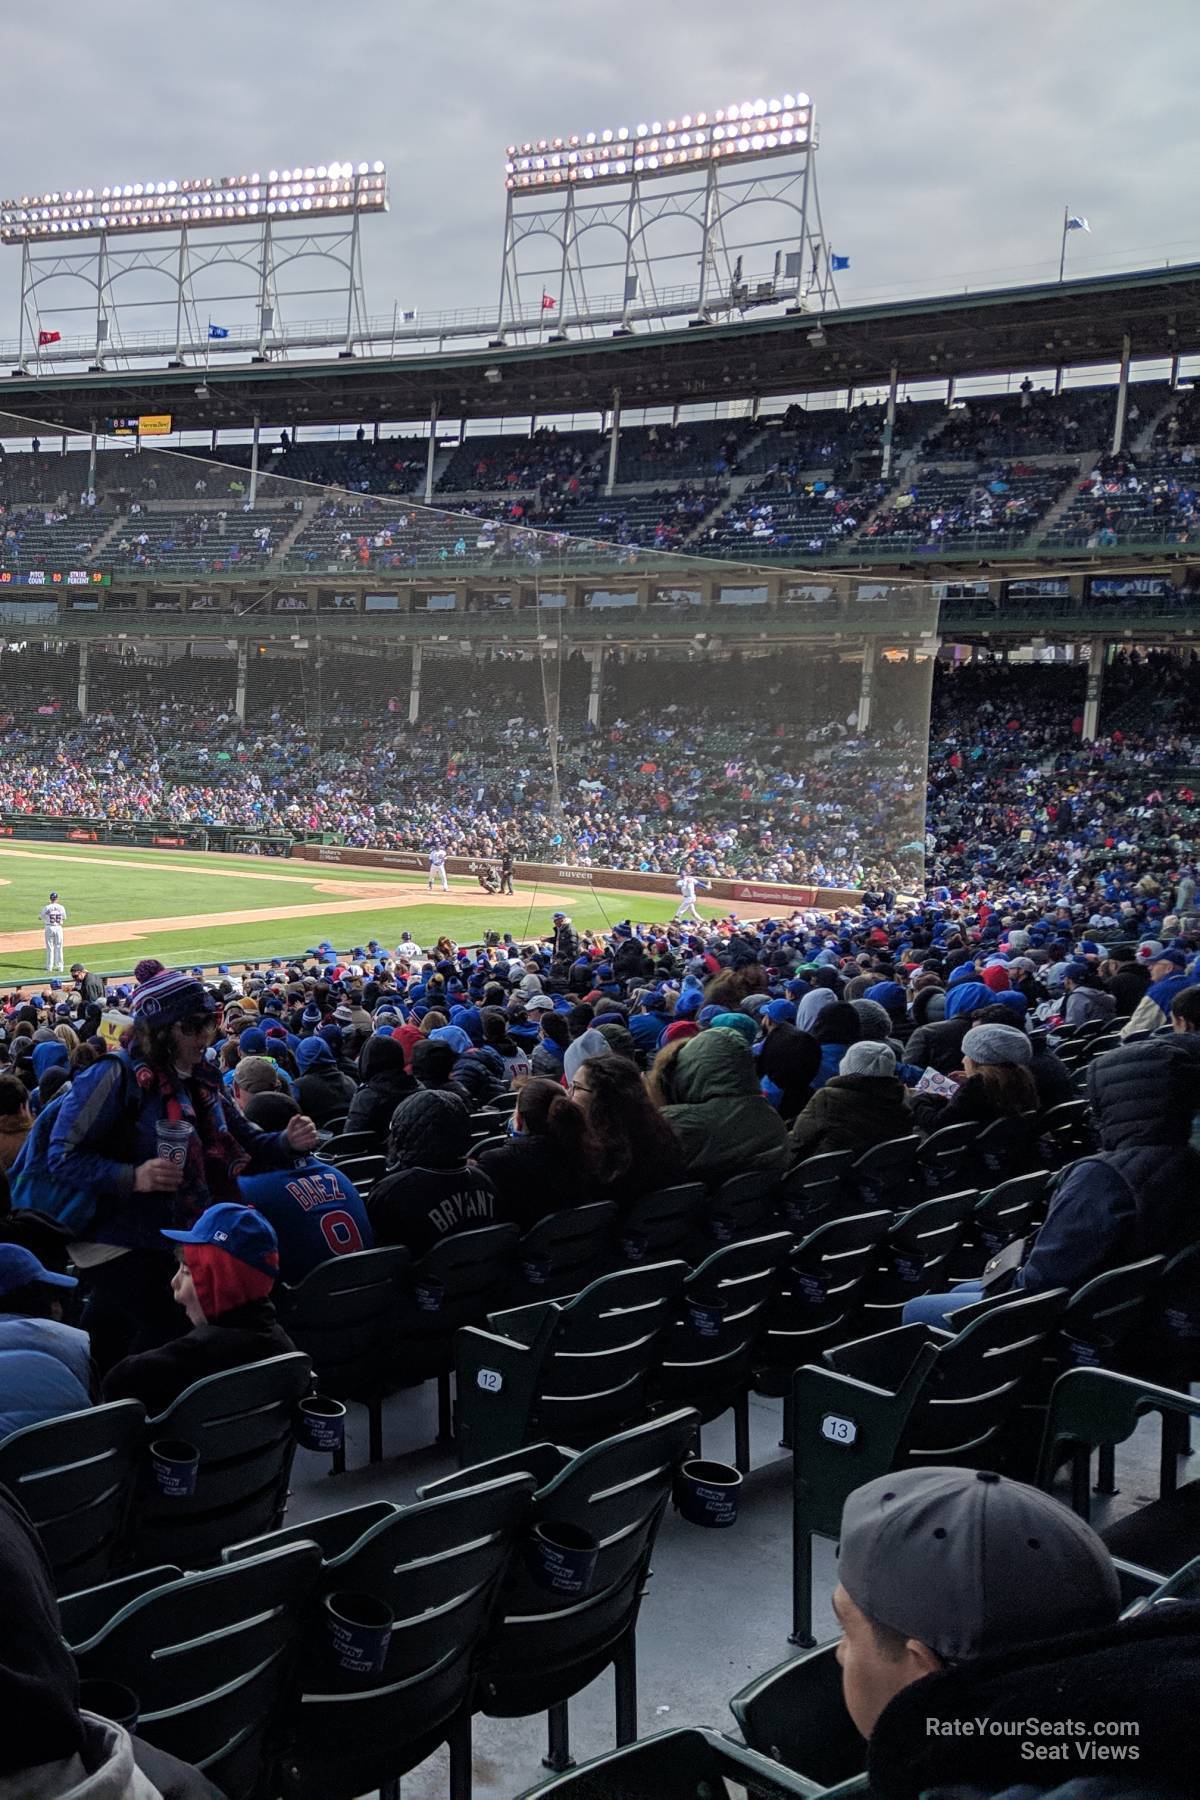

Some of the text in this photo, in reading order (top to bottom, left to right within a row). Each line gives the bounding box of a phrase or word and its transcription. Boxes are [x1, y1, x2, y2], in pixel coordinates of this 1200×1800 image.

[28, 577, 46, 585] COUNT
[67, 577, 89, 585] PERCENT
[559, 870, 593, 880] nuveen
[285, 1173, 346, 1212] BAEZ
[428, 1190, 497, 1233] BRYANT
[482, 1373, 497, 1388] 12
[830, 1421, 848, 1439] 13
